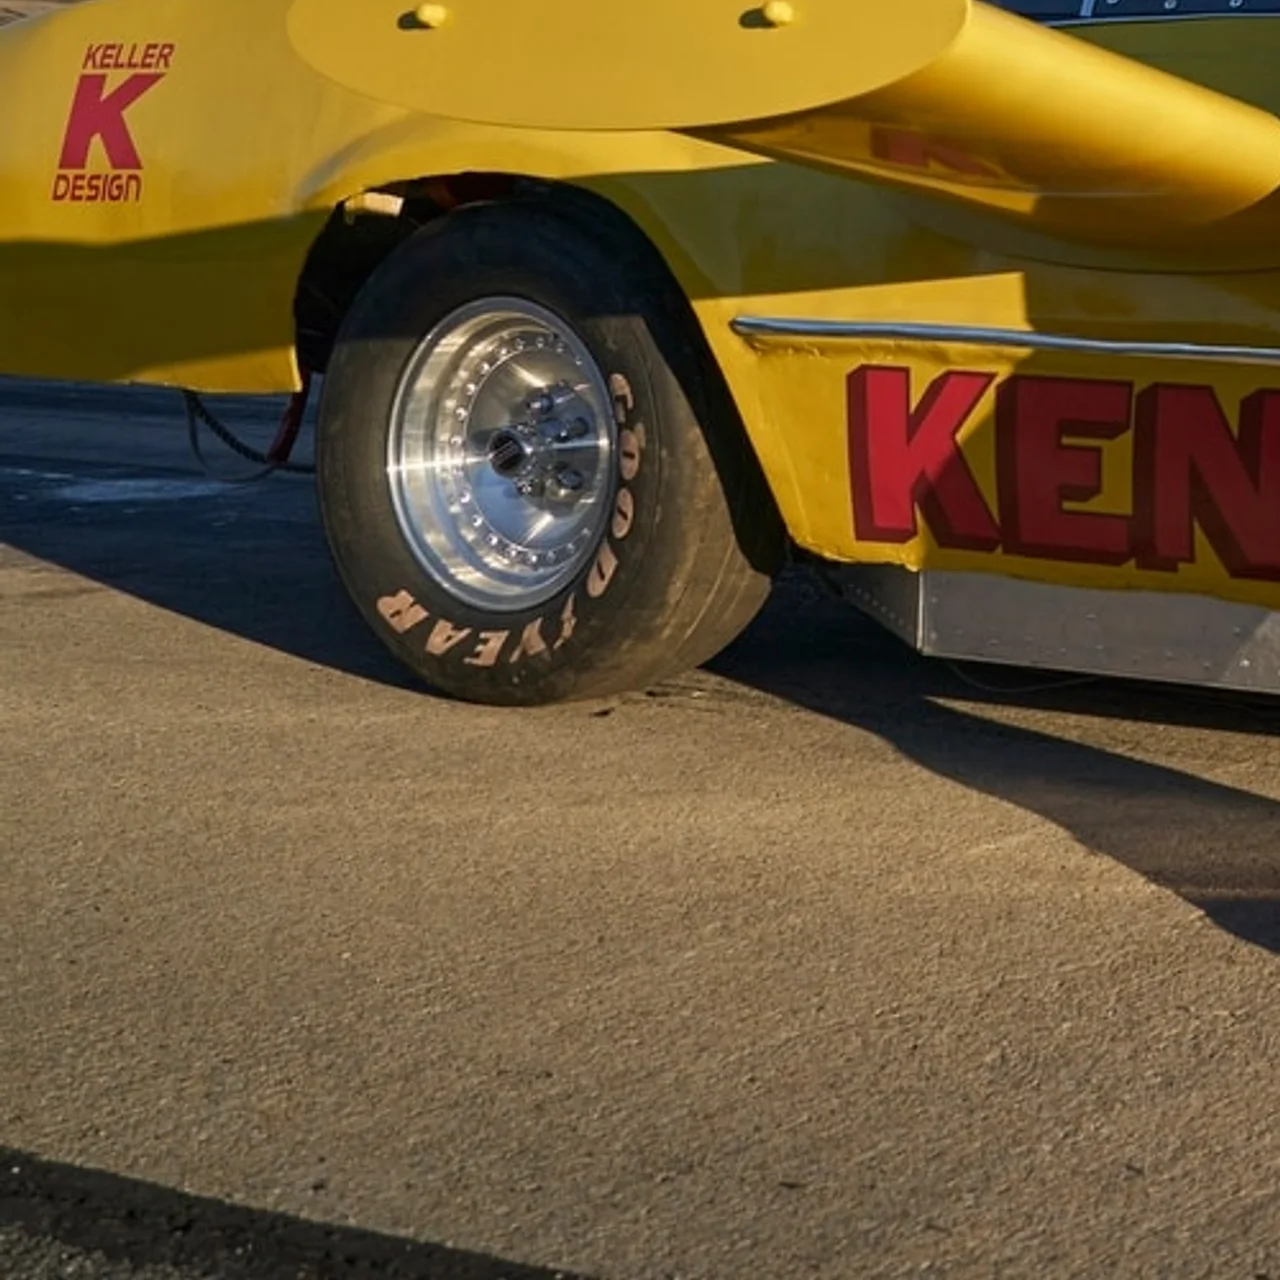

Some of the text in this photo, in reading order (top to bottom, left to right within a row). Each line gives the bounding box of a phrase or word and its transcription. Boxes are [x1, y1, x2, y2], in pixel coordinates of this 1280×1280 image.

[82, 43, 175, 69] KELLER
[58, 72, 167, 170] K
[51, 174, 143, 202] DESIGN
